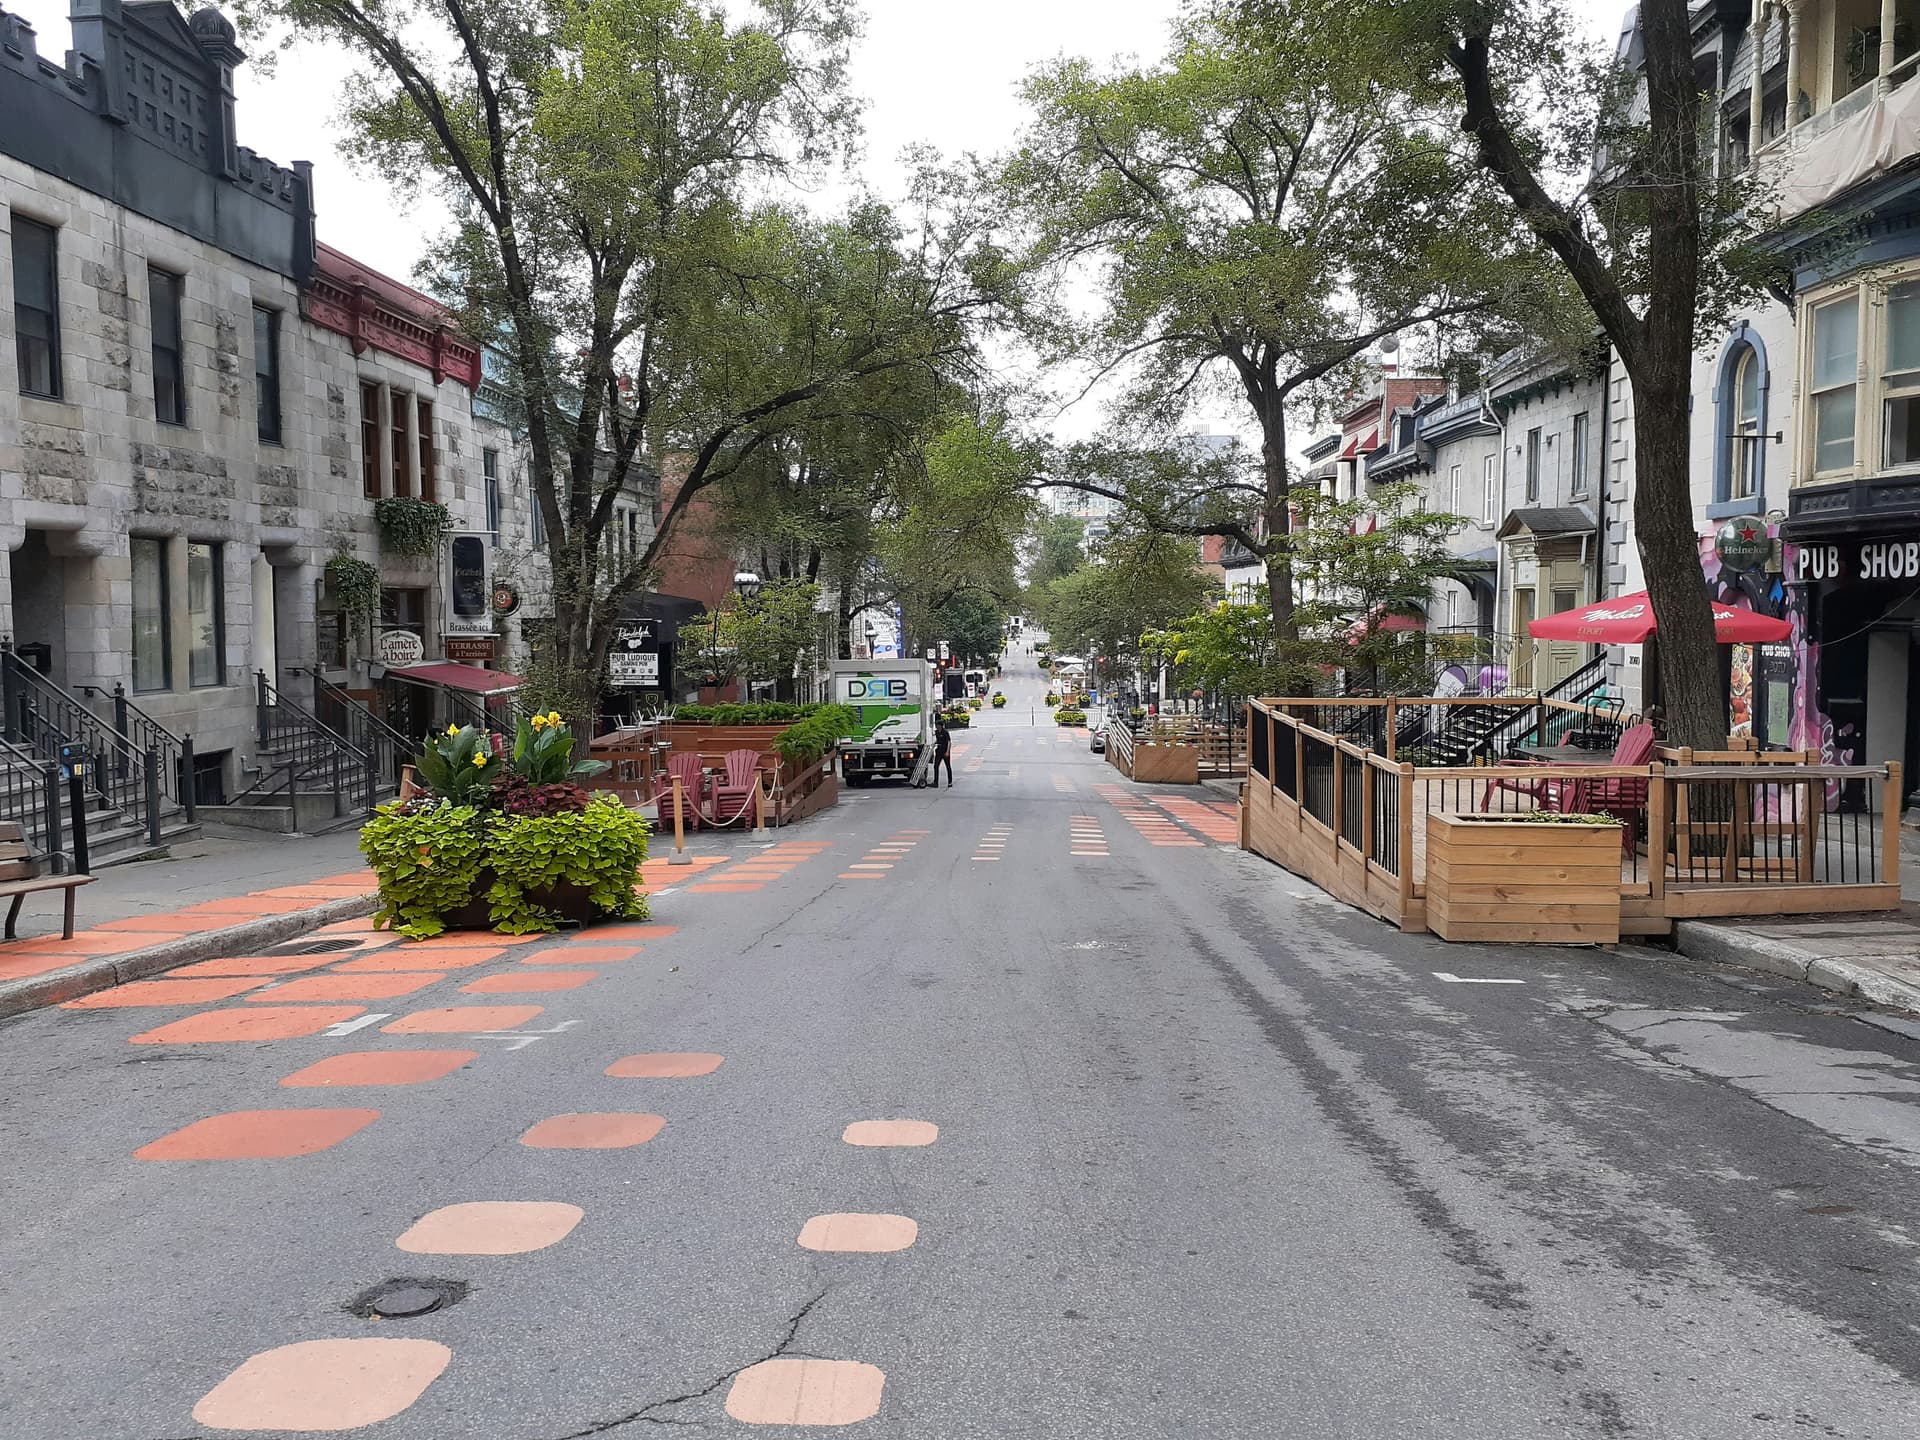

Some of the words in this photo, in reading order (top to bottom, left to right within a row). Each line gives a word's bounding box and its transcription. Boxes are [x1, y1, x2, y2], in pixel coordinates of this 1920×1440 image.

[1799, 546, 1839, 579] PUB
[1860, 543, 1920, 579] SHOB
[380, 638, 418, 650] L'amère
[390, 650, 417, 660] boire
[1761, 645, 1774, 656] PUB
